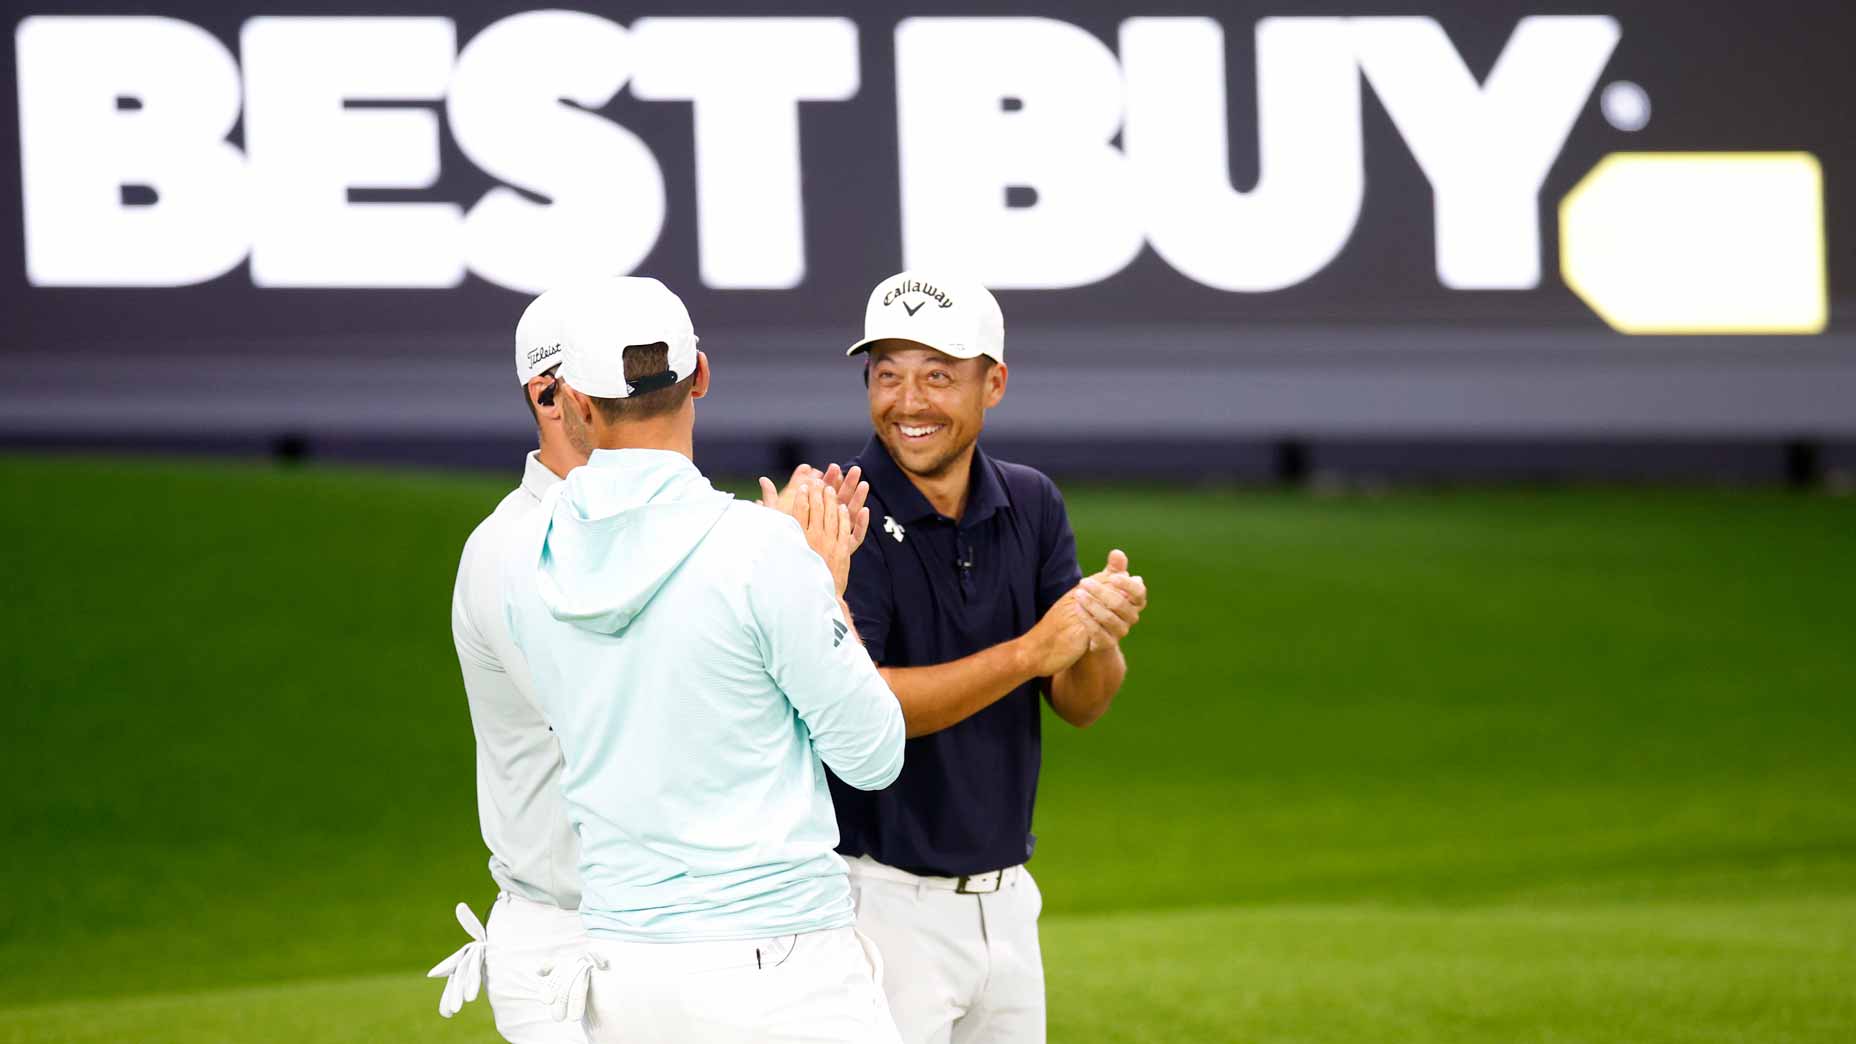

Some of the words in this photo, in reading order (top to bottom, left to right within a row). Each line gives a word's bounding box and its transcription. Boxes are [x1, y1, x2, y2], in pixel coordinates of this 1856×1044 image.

[15, 9, 860, 294] BEST
[893, 14, 1621, 292] BUY
[882, 279, 953, 308] Callaway
[527, 342, 562, 369] Titleist
